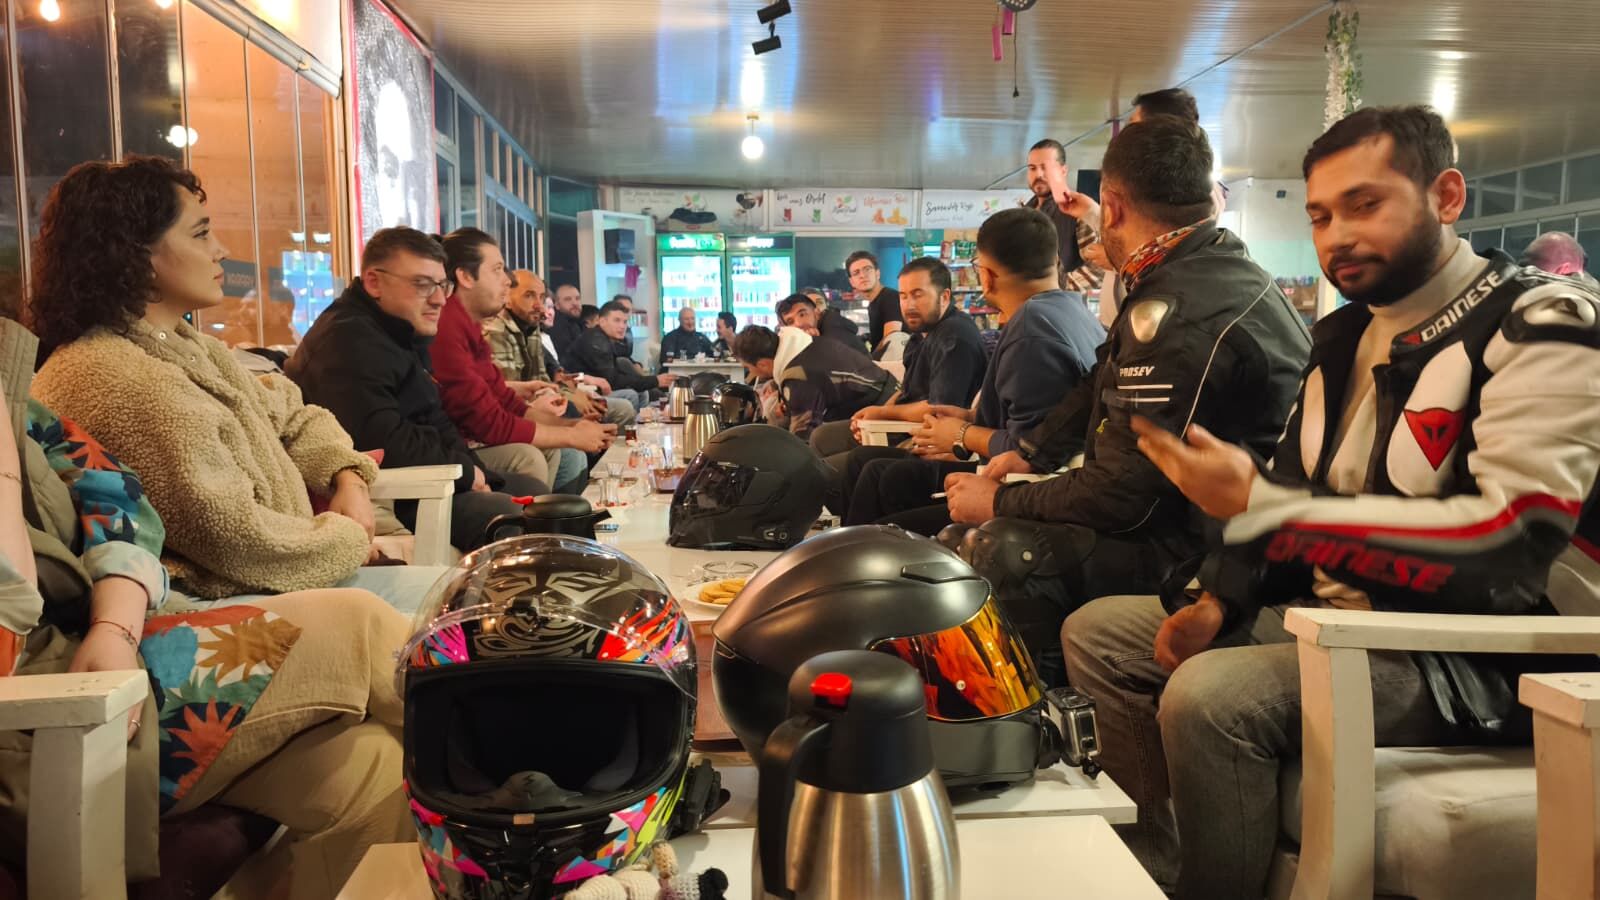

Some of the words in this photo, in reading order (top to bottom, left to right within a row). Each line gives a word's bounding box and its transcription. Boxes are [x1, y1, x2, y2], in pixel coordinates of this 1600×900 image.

[1420, 271, 1503, 342] DAINESE
[1119, 366, 1155, 377] PROSEV
[1265, 532, 1454, 593] DAINESE
